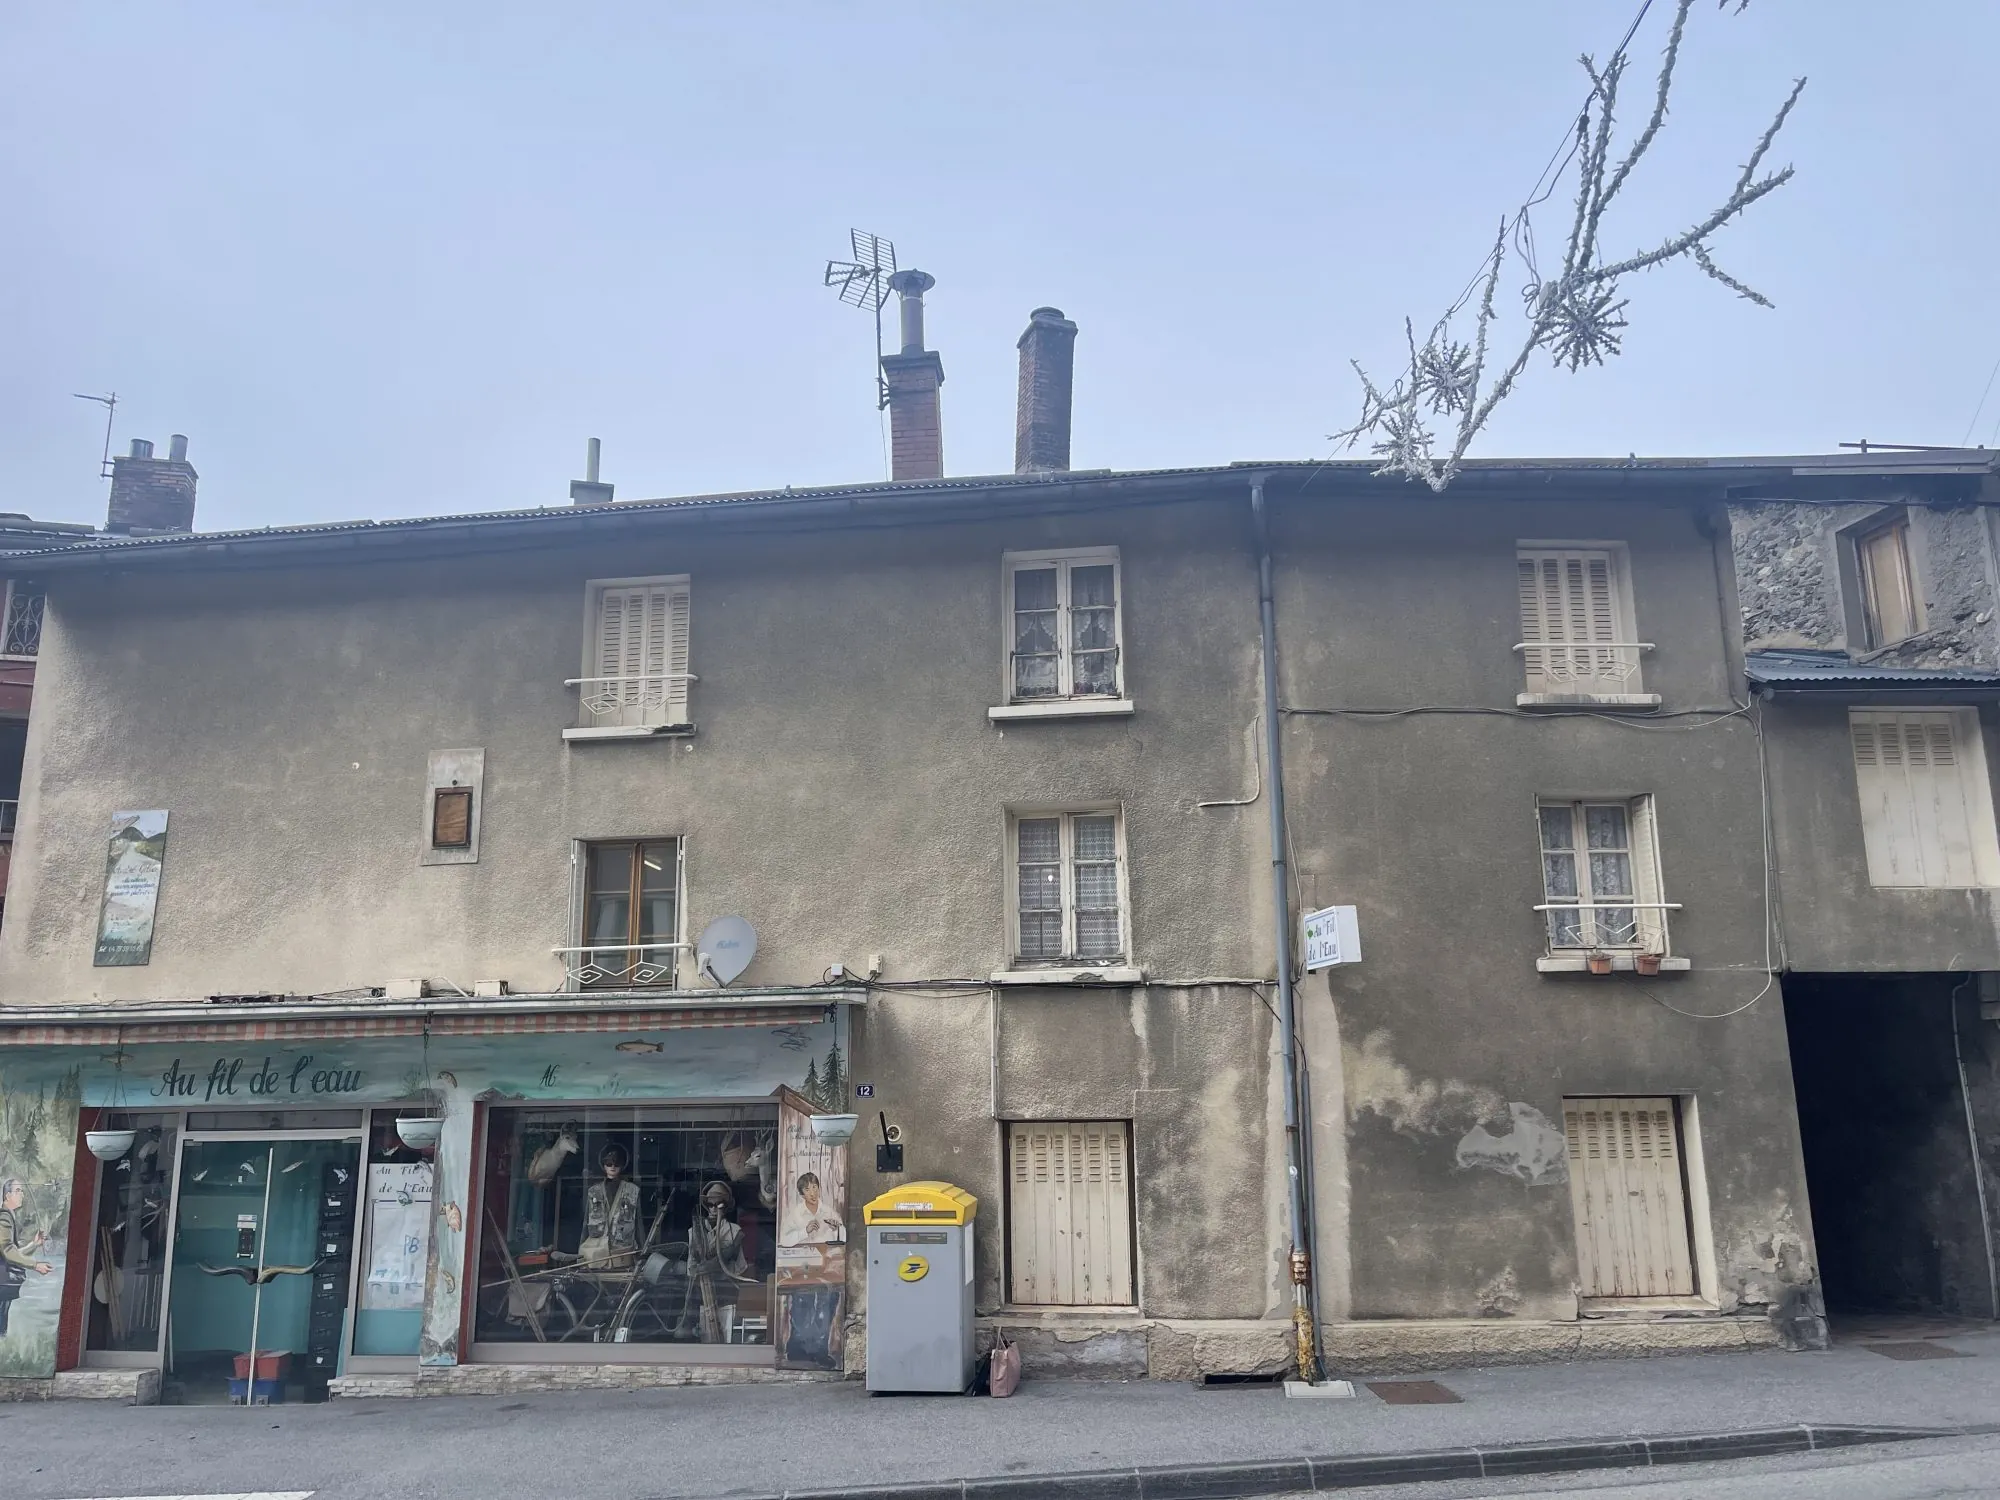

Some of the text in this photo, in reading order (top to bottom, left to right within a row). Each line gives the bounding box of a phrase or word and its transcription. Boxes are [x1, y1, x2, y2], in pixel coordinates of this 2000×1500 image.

[1313, 917, 1335, 938] Au Fil
[1308, 944, 1316, 960] de
[151, 1056, 361, 1101] Au fil de l'eau
[860, 1086, 870, 1096] 12
[376, 1166, 392, 1175] Au
[378, 1182, 392, 1193] de
